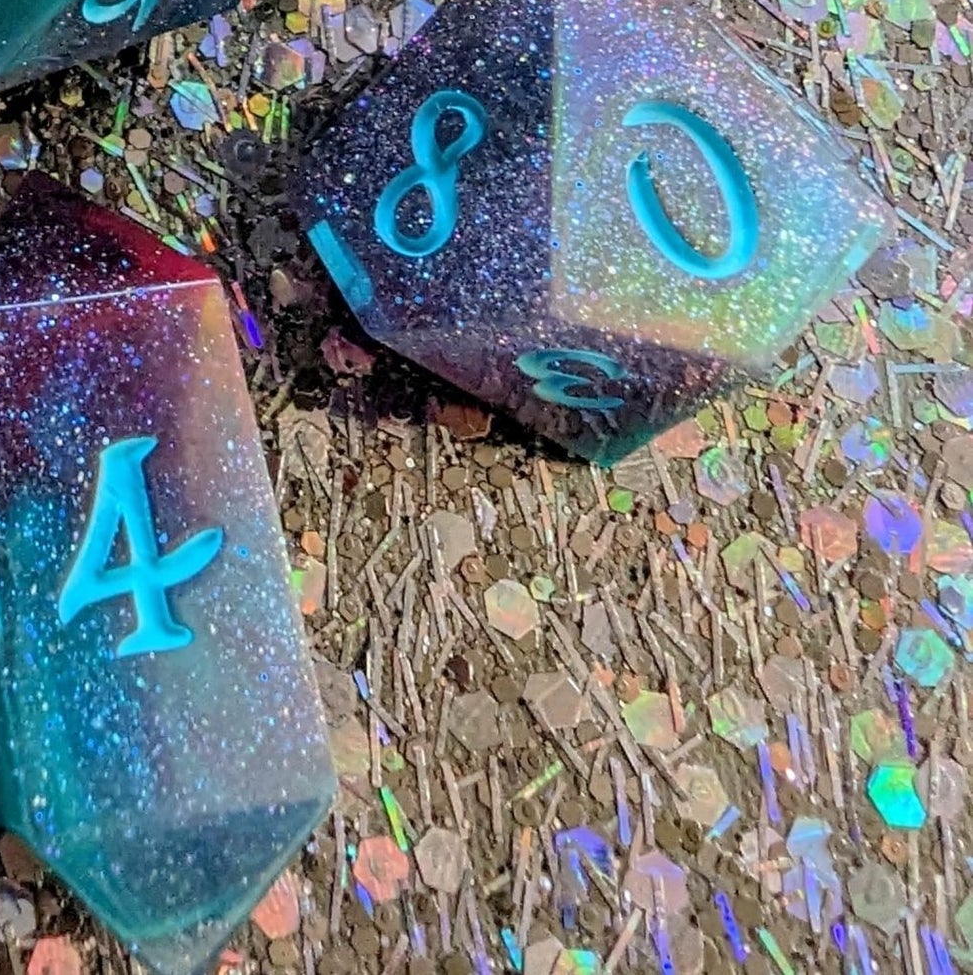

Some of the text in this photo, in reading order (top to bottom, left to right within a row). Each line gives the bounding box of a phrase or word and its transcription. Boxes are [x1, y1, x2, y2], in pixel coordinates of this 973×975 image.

[374, 90, 486, 257] 8
[624, 101, 759, 280] 0
[58, 434, 224, 658] 4
